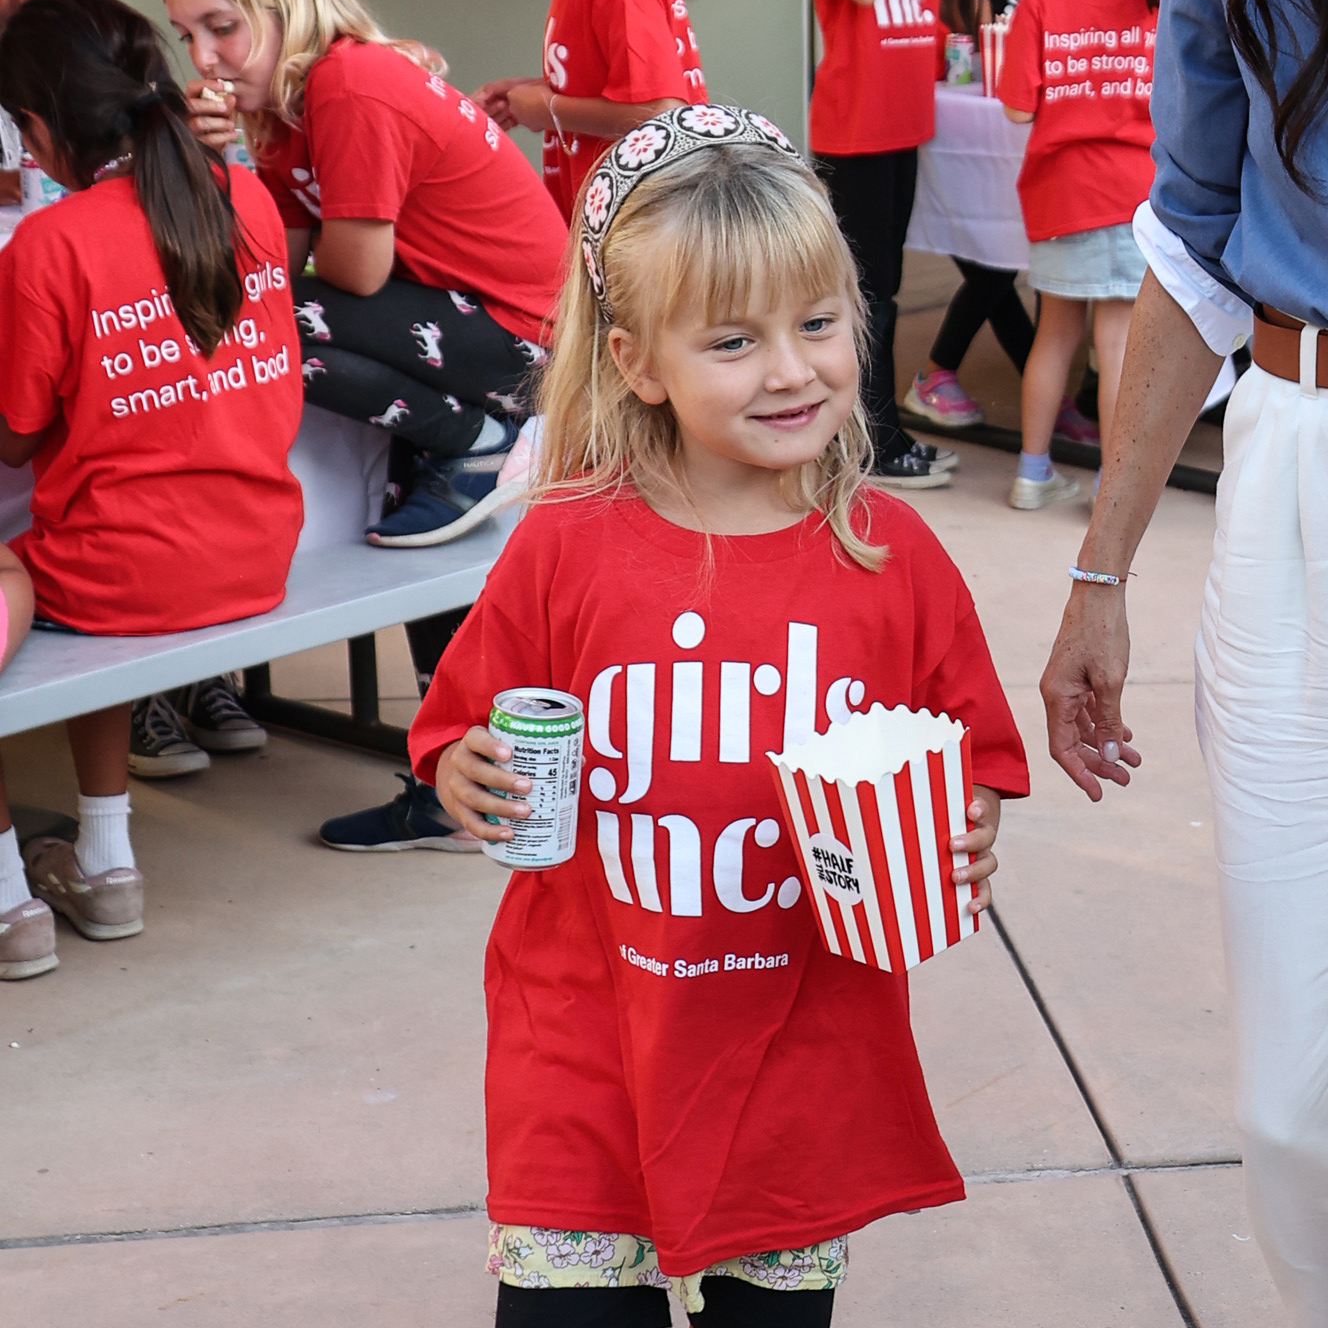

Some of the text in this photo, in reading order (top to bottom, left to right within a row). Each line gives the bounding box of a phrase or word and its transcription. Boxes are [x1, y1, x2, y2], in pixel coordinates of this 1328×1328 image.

[1044, 27, 1116, 50] Inspiring
[1121, 26, 1140, 44] all
[1044, 54, 1149, 75] to be strong,
[1045, 78, 1153, 102] smart, and bo
[91, 260, 286, 339] Inspir girls
[101, 352, 133, 379] to
[138, 338, 180, 369] be
[110, 374, 208, 419] smart,
[545, 723, 570, 733] GOOD
[514, 745, 559, 755] Nutrition Facts
[547, 767, 558, 777] 45
[594, 809, 802, 918] inc.
[811, 846, 854, 875] #HALF
[824, 869, 861, 895] STORY
[627, 946, 670, 977] Greater
[673, 957, 719, 978] Santa
[723, 951, 789, 972] Barbara
